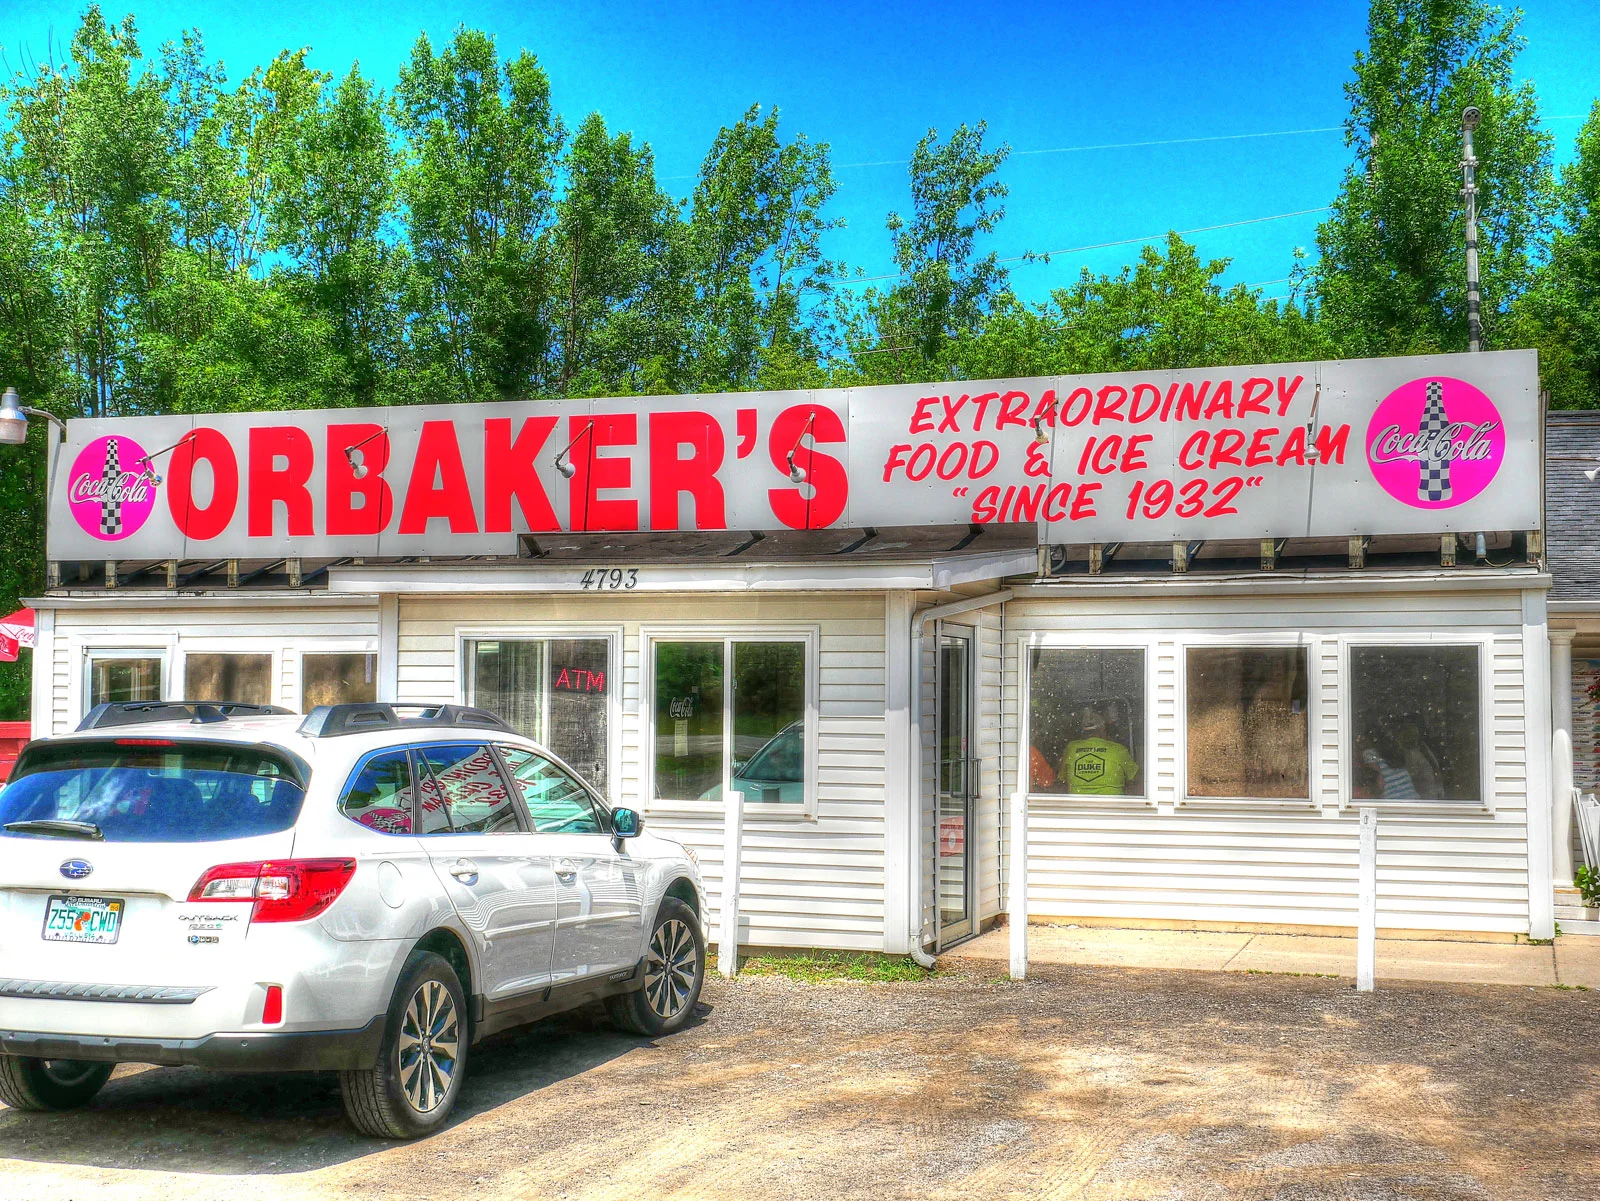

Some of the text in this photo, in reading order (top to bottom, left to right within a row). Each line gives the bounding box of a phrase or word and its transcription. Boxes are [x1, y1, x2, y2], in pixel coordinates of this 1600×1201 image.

[909, 375, 1304, 434] EXTRAORDINARY
[882, 423, 1351, 483] FOOD & ICE CREAM
[1370, 421, 1498, 464] Coca-Cola
[70, 472, 149, 504] Coca-Cola
[167, 403, 848, 541] ORBAKER'S
[580, 568, 640, 590] 4793
[555, 668, 605, 692] ATM
[1078, 763, 1101, 771] DUKE
[89, 910, 116, 933] CWD
